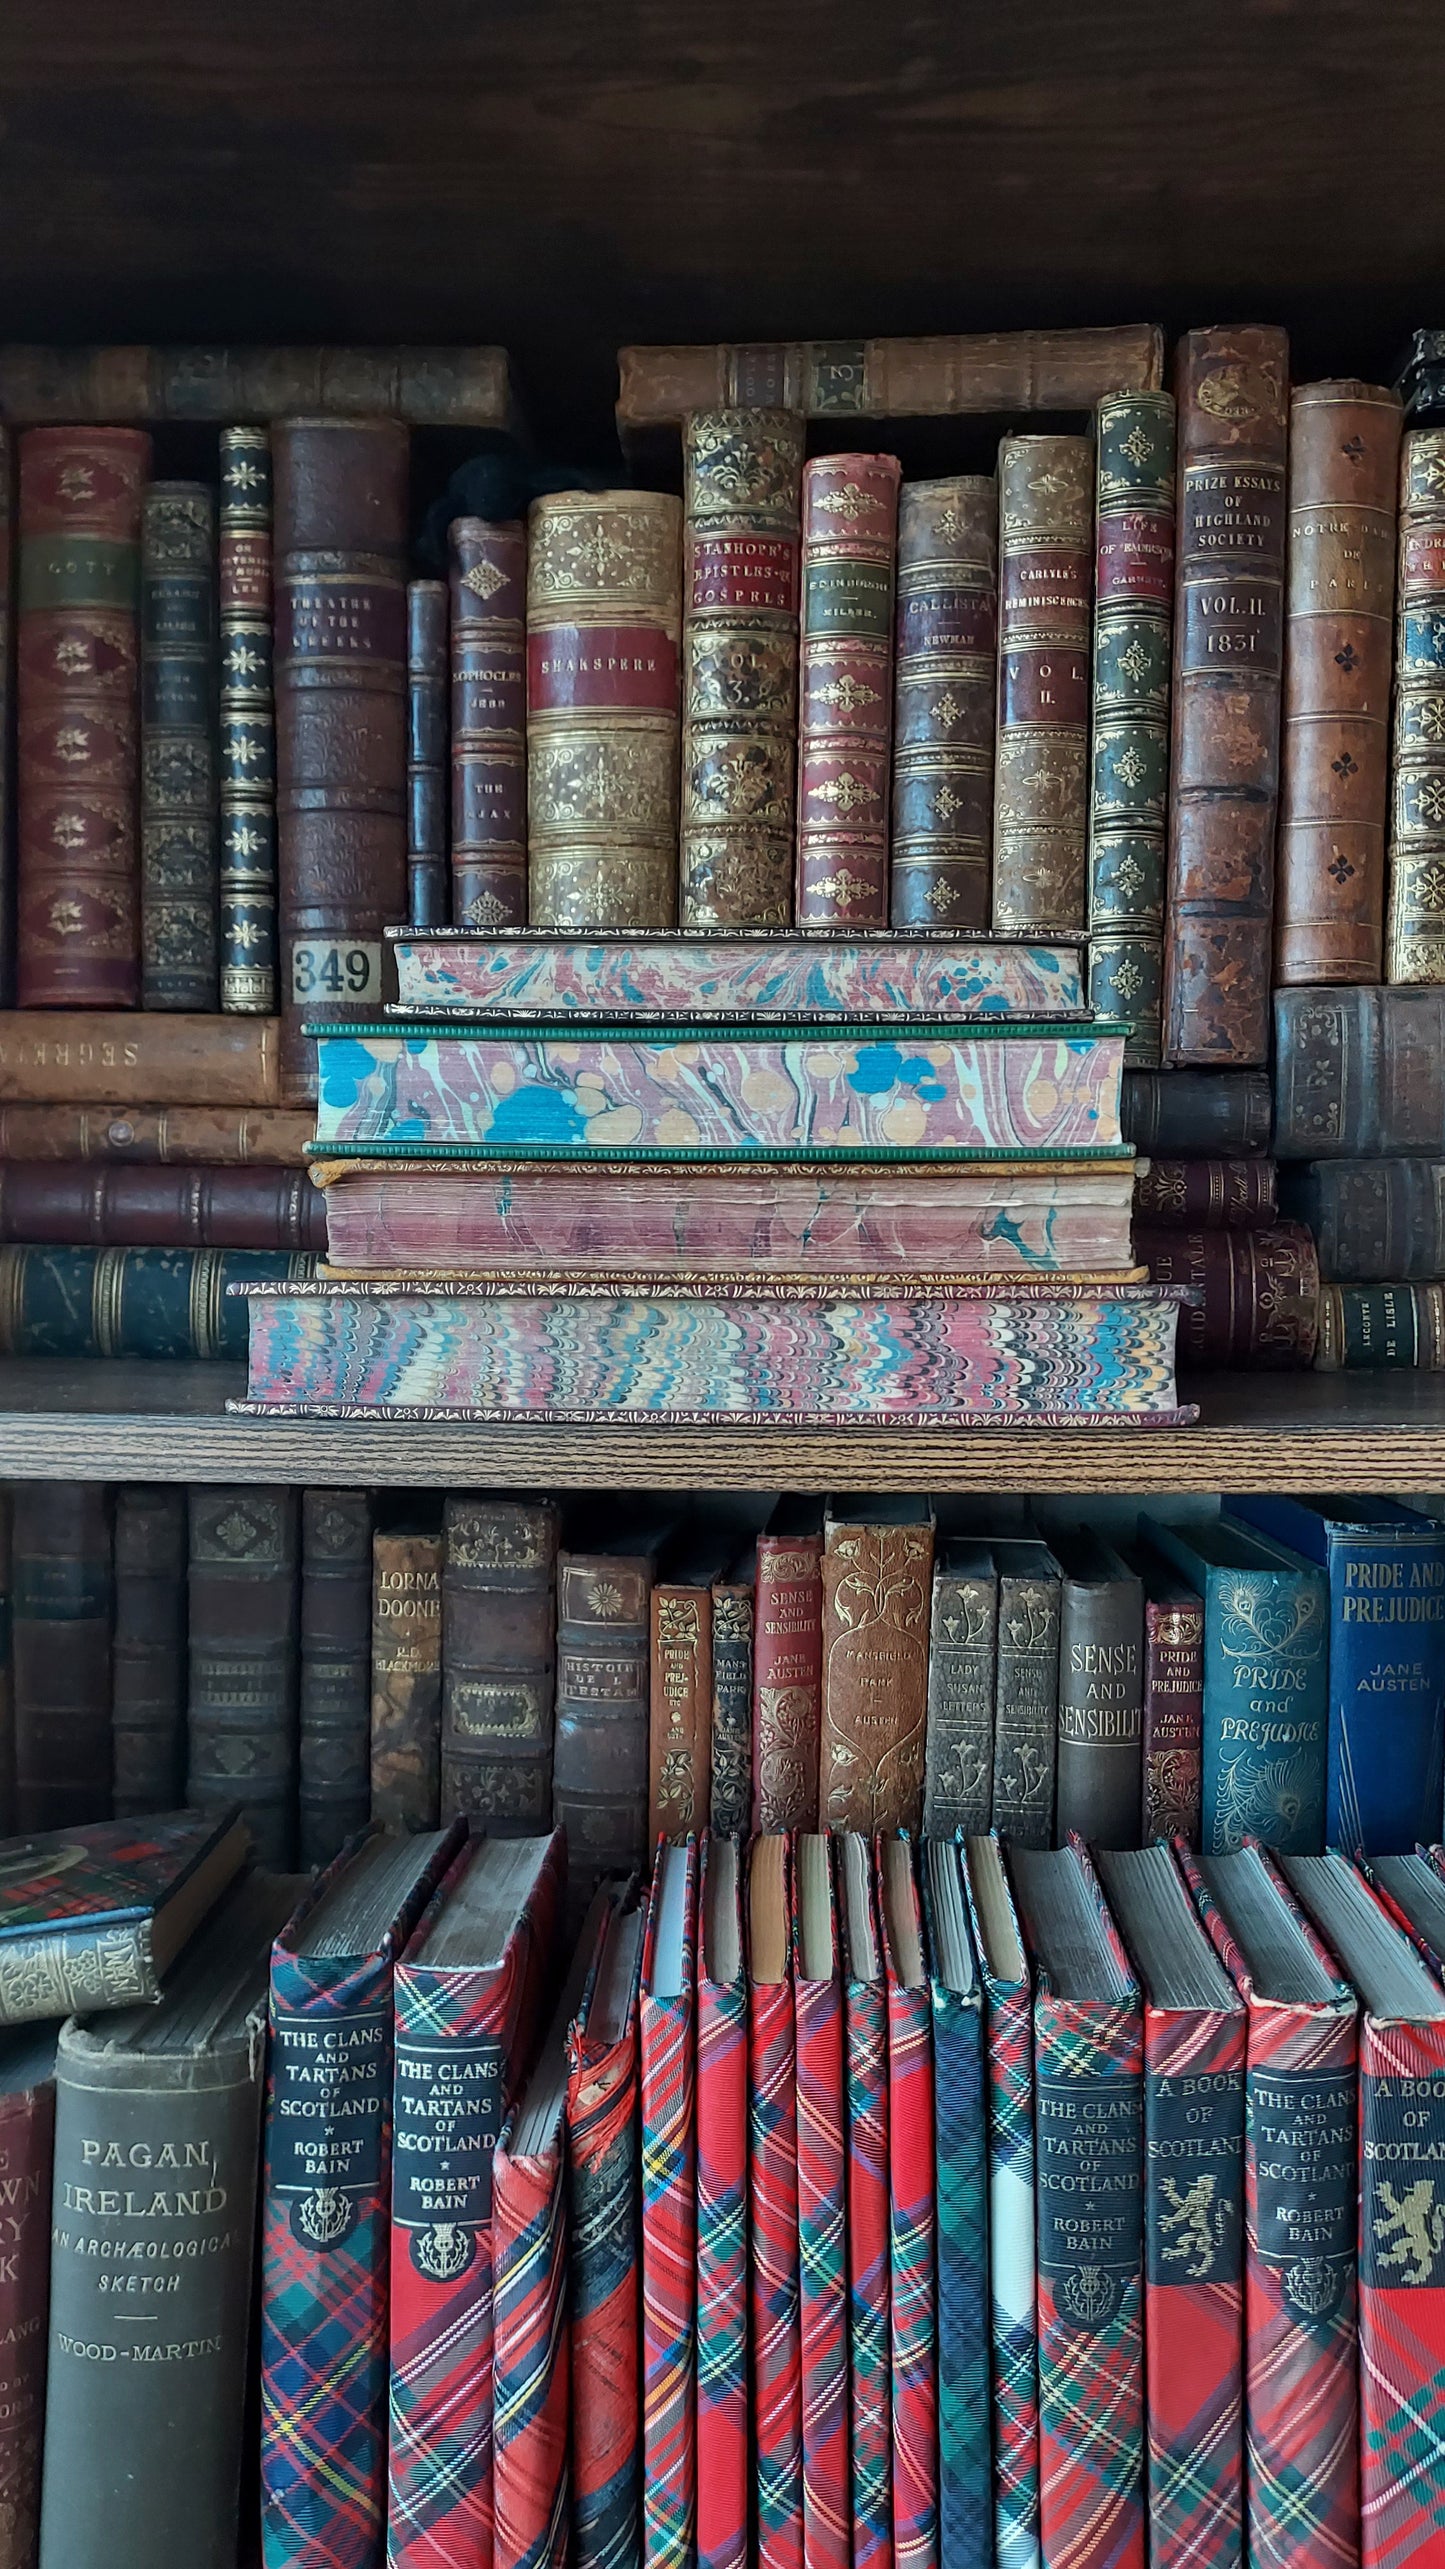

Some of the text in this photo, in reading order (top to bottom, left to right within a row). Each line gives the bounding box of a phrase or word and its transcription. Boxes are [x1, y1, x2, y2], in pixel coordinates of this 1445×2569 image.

[1186, 476, 1281, 493] PRIZE ESSAYS
[1224, 496, 1243, 508] OF
[1195, 514, 1271, 529] HIGHLAND
[1292, 522, 1351, 539] NOTRE
[1100, 543, 1117, 555] OF
[1198, 534, 1265, 548] SOCIETY
[694, 542, 790, 560] STANHOPE'S
[1020, 564, 1079, 581] CARLYLE'S
[693, 590, 785, 606] GOSPELS
[909, 598, 989, 615] CALLISTA
[924, 633, 975, 646] NEWMAN
[1206, 634, 1257, 652] 1831
[541, 658, 657, 674] SHAKSPERE
[294, 948, 371, 994] 349
[1386, 1292, 1396, 1357] DE LISLE
[380, 1571, 440, 1591] LORNA
[1345, 1561, 1445, 1589] PRIDE AND
[770, 1589, 812, 1605] SENSE
[378, 1598, 440, 1618] DOONE
[779, 1607, 804, 1618] AND
[1342, 1595, 1445, 1624] PREJUDICE
[764, 1620, 816, 1635] SENSIBILITY
[664, 1649, 690, 1660] PRIDE
[773, 1654, 806, 1666] JANE
[1070, 1643, 1137, 1676] SENSE
[1159, 1651, 1198, 1664] PRIDE
[767, 1665, 814, 1681] AUSTEN
[951, 1664, 979, 1676] LADY
[1166, 1667, 1191, 1677] AND
[1231, 1664, 1308, 1692] PRIDE
[1370, 1663, 1423, 1676] JANE
[663, 1686, 689, 1698] UDICE
[946, 1682, 983, 1695] SUSAN
[1086, 1682, 1126, 1700] AND
[1151, 1679, 1203, 1695] PREJUDICE
[1357, 1677, 1431, 1692] AUSTEN
[1250, 1696, 1294, 1714] and
[1058, 1703, 1142, 1739] SENSIBILIT
[1160, 1714, 1194, 1725] JANE
[1152, 1725, 1200, 1739] AUSTEN
[1219, 1716, 1320, 1751] PREJUDICE
[280, 2028, 383, 2049] THE CLANS
[314, 2051, 349, 2064] AND
[285, 2063, 377, 2084] TARTANS
[398, 2059, 499, 2080] THE CLANS
[320, 2087, 340, 2099] OF
[429, 2083, 464, 2096] AND
[1155, 2072, 1242, 2097] A BOOK
[1374, 2079, 1445, 2098] A BOO
[1254, 2087, 1356, 2110] THE CLANS
[280, 2098, 380, 2118] SCOTLAND
[401, 2097, 492, 2118] TARTANS
[1040, 2099, 1077, 2119] THE
[1185, 2105, 1214, 2124] OF
[435, 2120, 456, 2132] OF
[1292, 2114, 1327, 2126] AND
[1403, 2111, 1430, 2128] OF
[1072, 2123, 1108, 2135] AND
[1261, 2125, 1354, 2147] TARTANS
[293, 2140, 364, 2156] ROBERT
[397, 2132, 496, 2152] SCOTLAND
[1043, 2136, 1137, 2156] TARTANS
[80, 2138, 210, 2169] PAGAN
[1300, 2151, 1322, 2162] OF
[305, 2158, 351, 2175] BAIN
[1080, 2159, 1101, 2172] OF
[409, 2175, 480, 2192] ROBERT
[63, 2181, 228, 2217] IRELAND
[421, 2194, 468, 2210] BAIN
[1276, 2205, 1344, 2224] ROBERT
[1054, 2217, 1126, 2232] ROBERT
[52, 2227, 70, 2247] AN
[1066, 2236, 1113, 2250] BAIN
[1289, 2227, 1333, 2243] BAIN
[98, 2273, 181, 2293] SKETCH
[57, 2331, 222, 2363] WOOD-MARTIN
